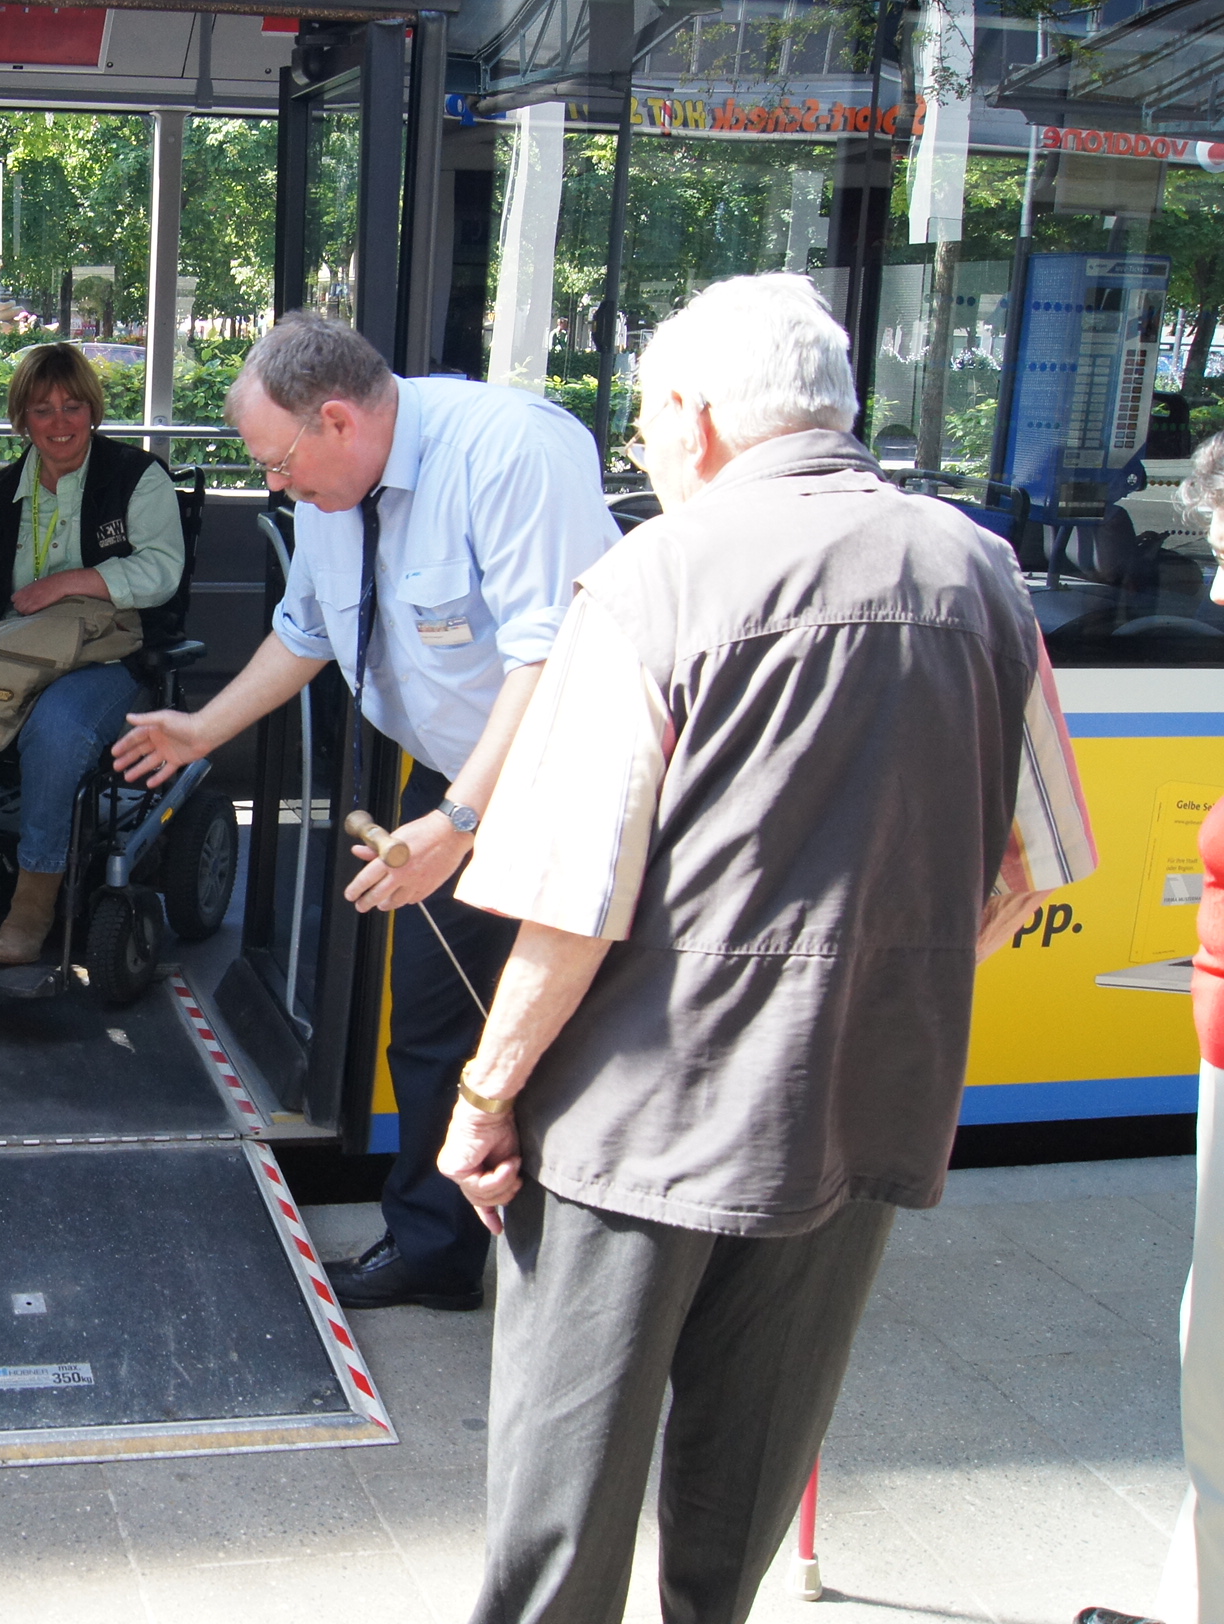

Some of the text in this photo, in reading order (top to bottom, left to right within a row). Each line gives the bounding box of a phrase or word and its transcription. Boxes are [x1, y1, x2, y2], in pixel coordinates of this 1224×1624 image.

[1176, 799, 1215, 812] Gelbe Se
[1012, 903, 1083, 948] pp.
[57, 1364, 82, 1372] max.
